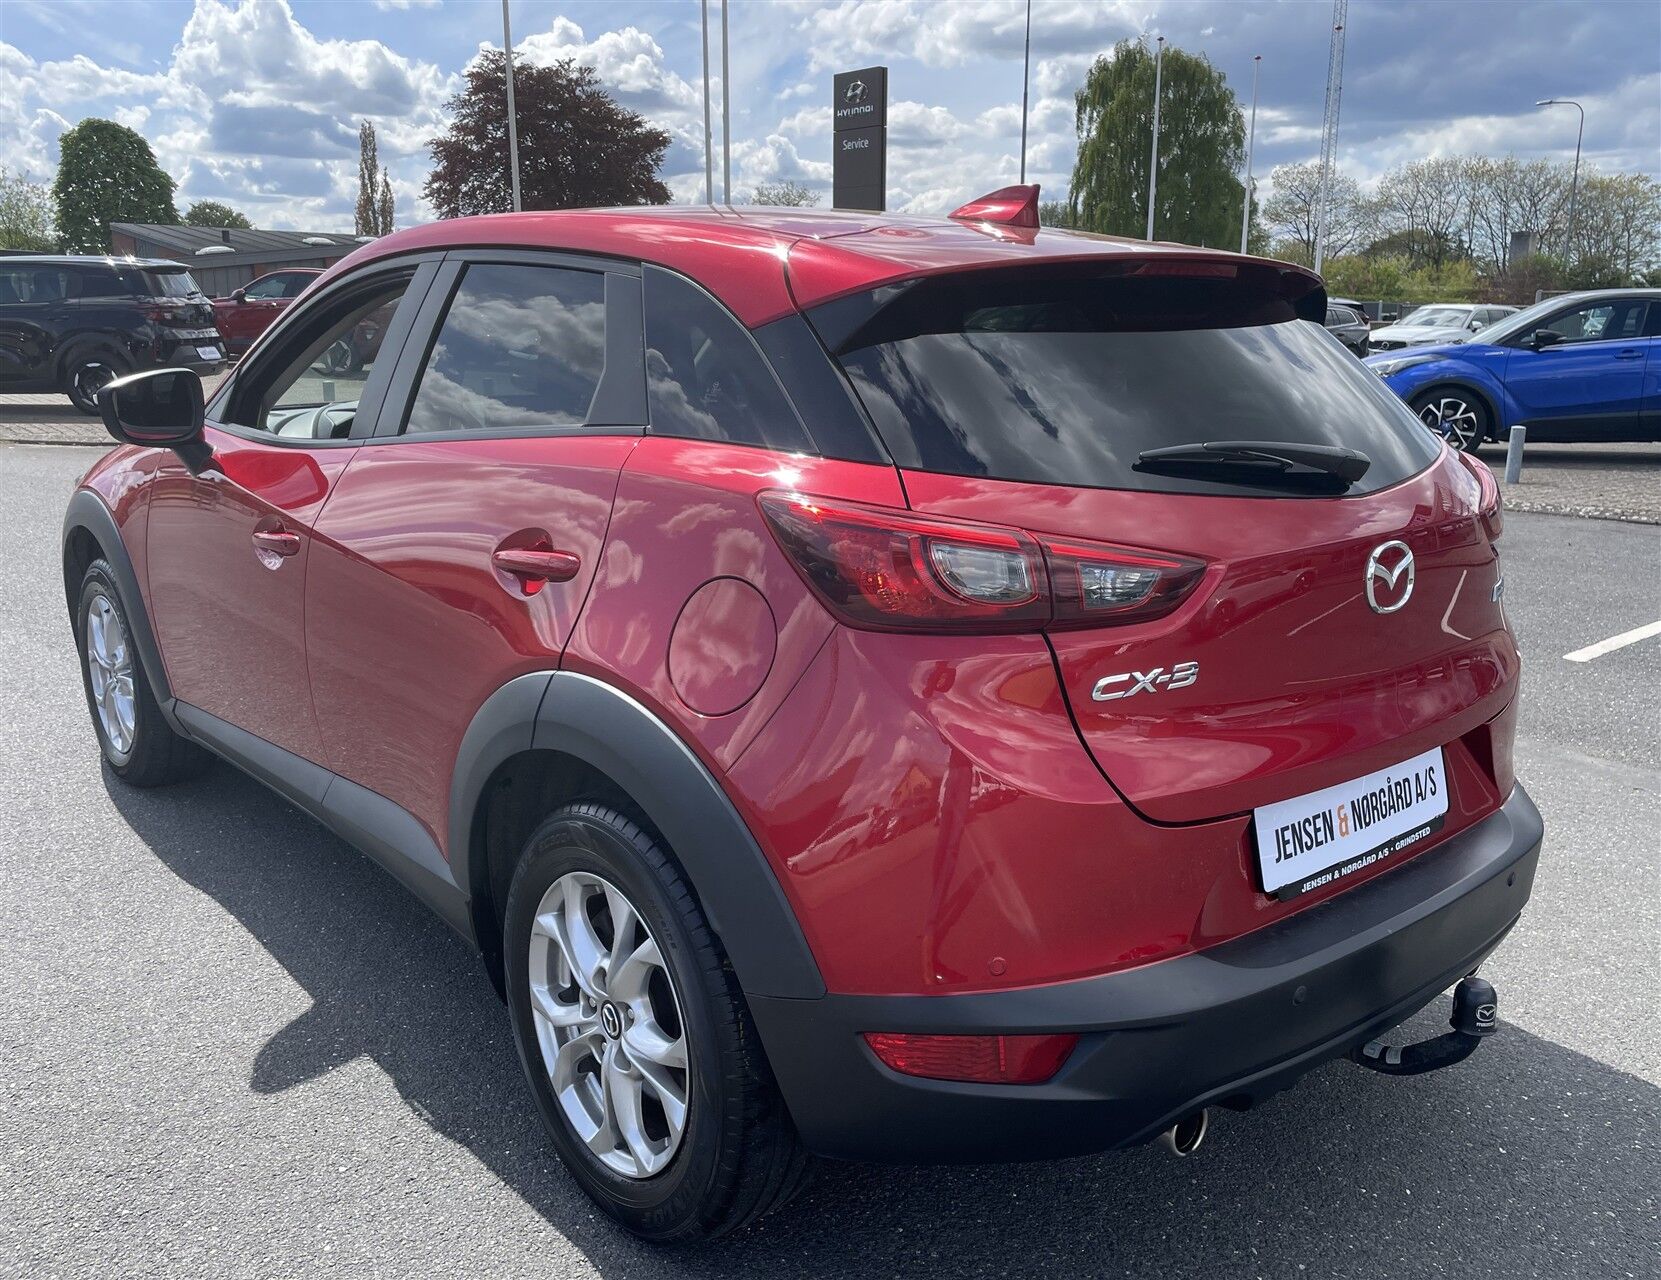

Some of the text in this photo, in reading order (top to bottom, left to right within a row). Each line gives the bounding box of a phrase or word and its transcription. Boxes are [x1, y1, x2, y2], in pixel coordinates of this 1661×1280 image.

[843, 138, 869, 151] Service
[1092, 661, 1199, 702] CX-3
[1274, 766, 1437, 864] JENSEN & NØRGÅRD A/S
[1301, 826, 1431, 893] JENSEN & NØRGÅRD A/S GRINDSTED
